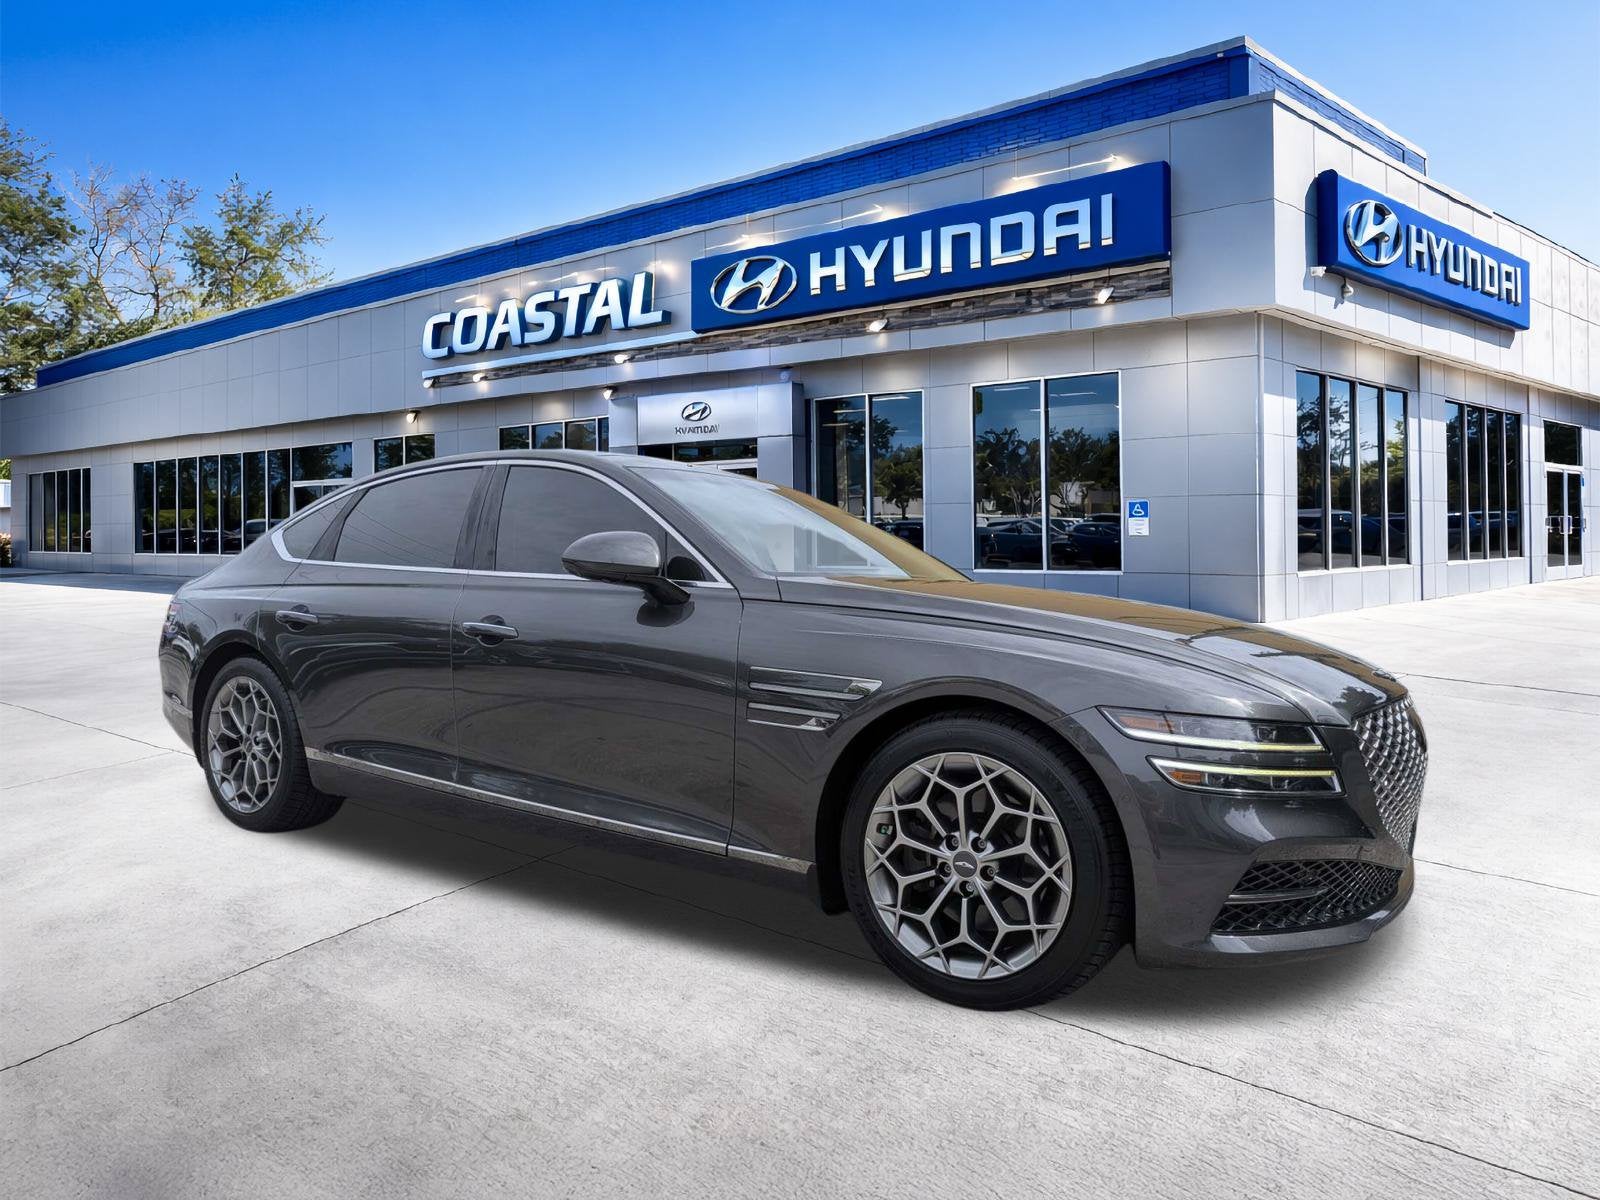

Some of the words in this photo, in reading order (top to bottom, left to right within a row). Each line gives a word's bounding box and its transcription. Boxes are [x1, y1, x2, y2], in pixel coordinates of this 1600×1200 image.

[809, 193, 1114, 296] HYUNDAI
[1406, 223, 1522, 306] HYUNDAI
[422, 271, 668, 360] COASTAL
